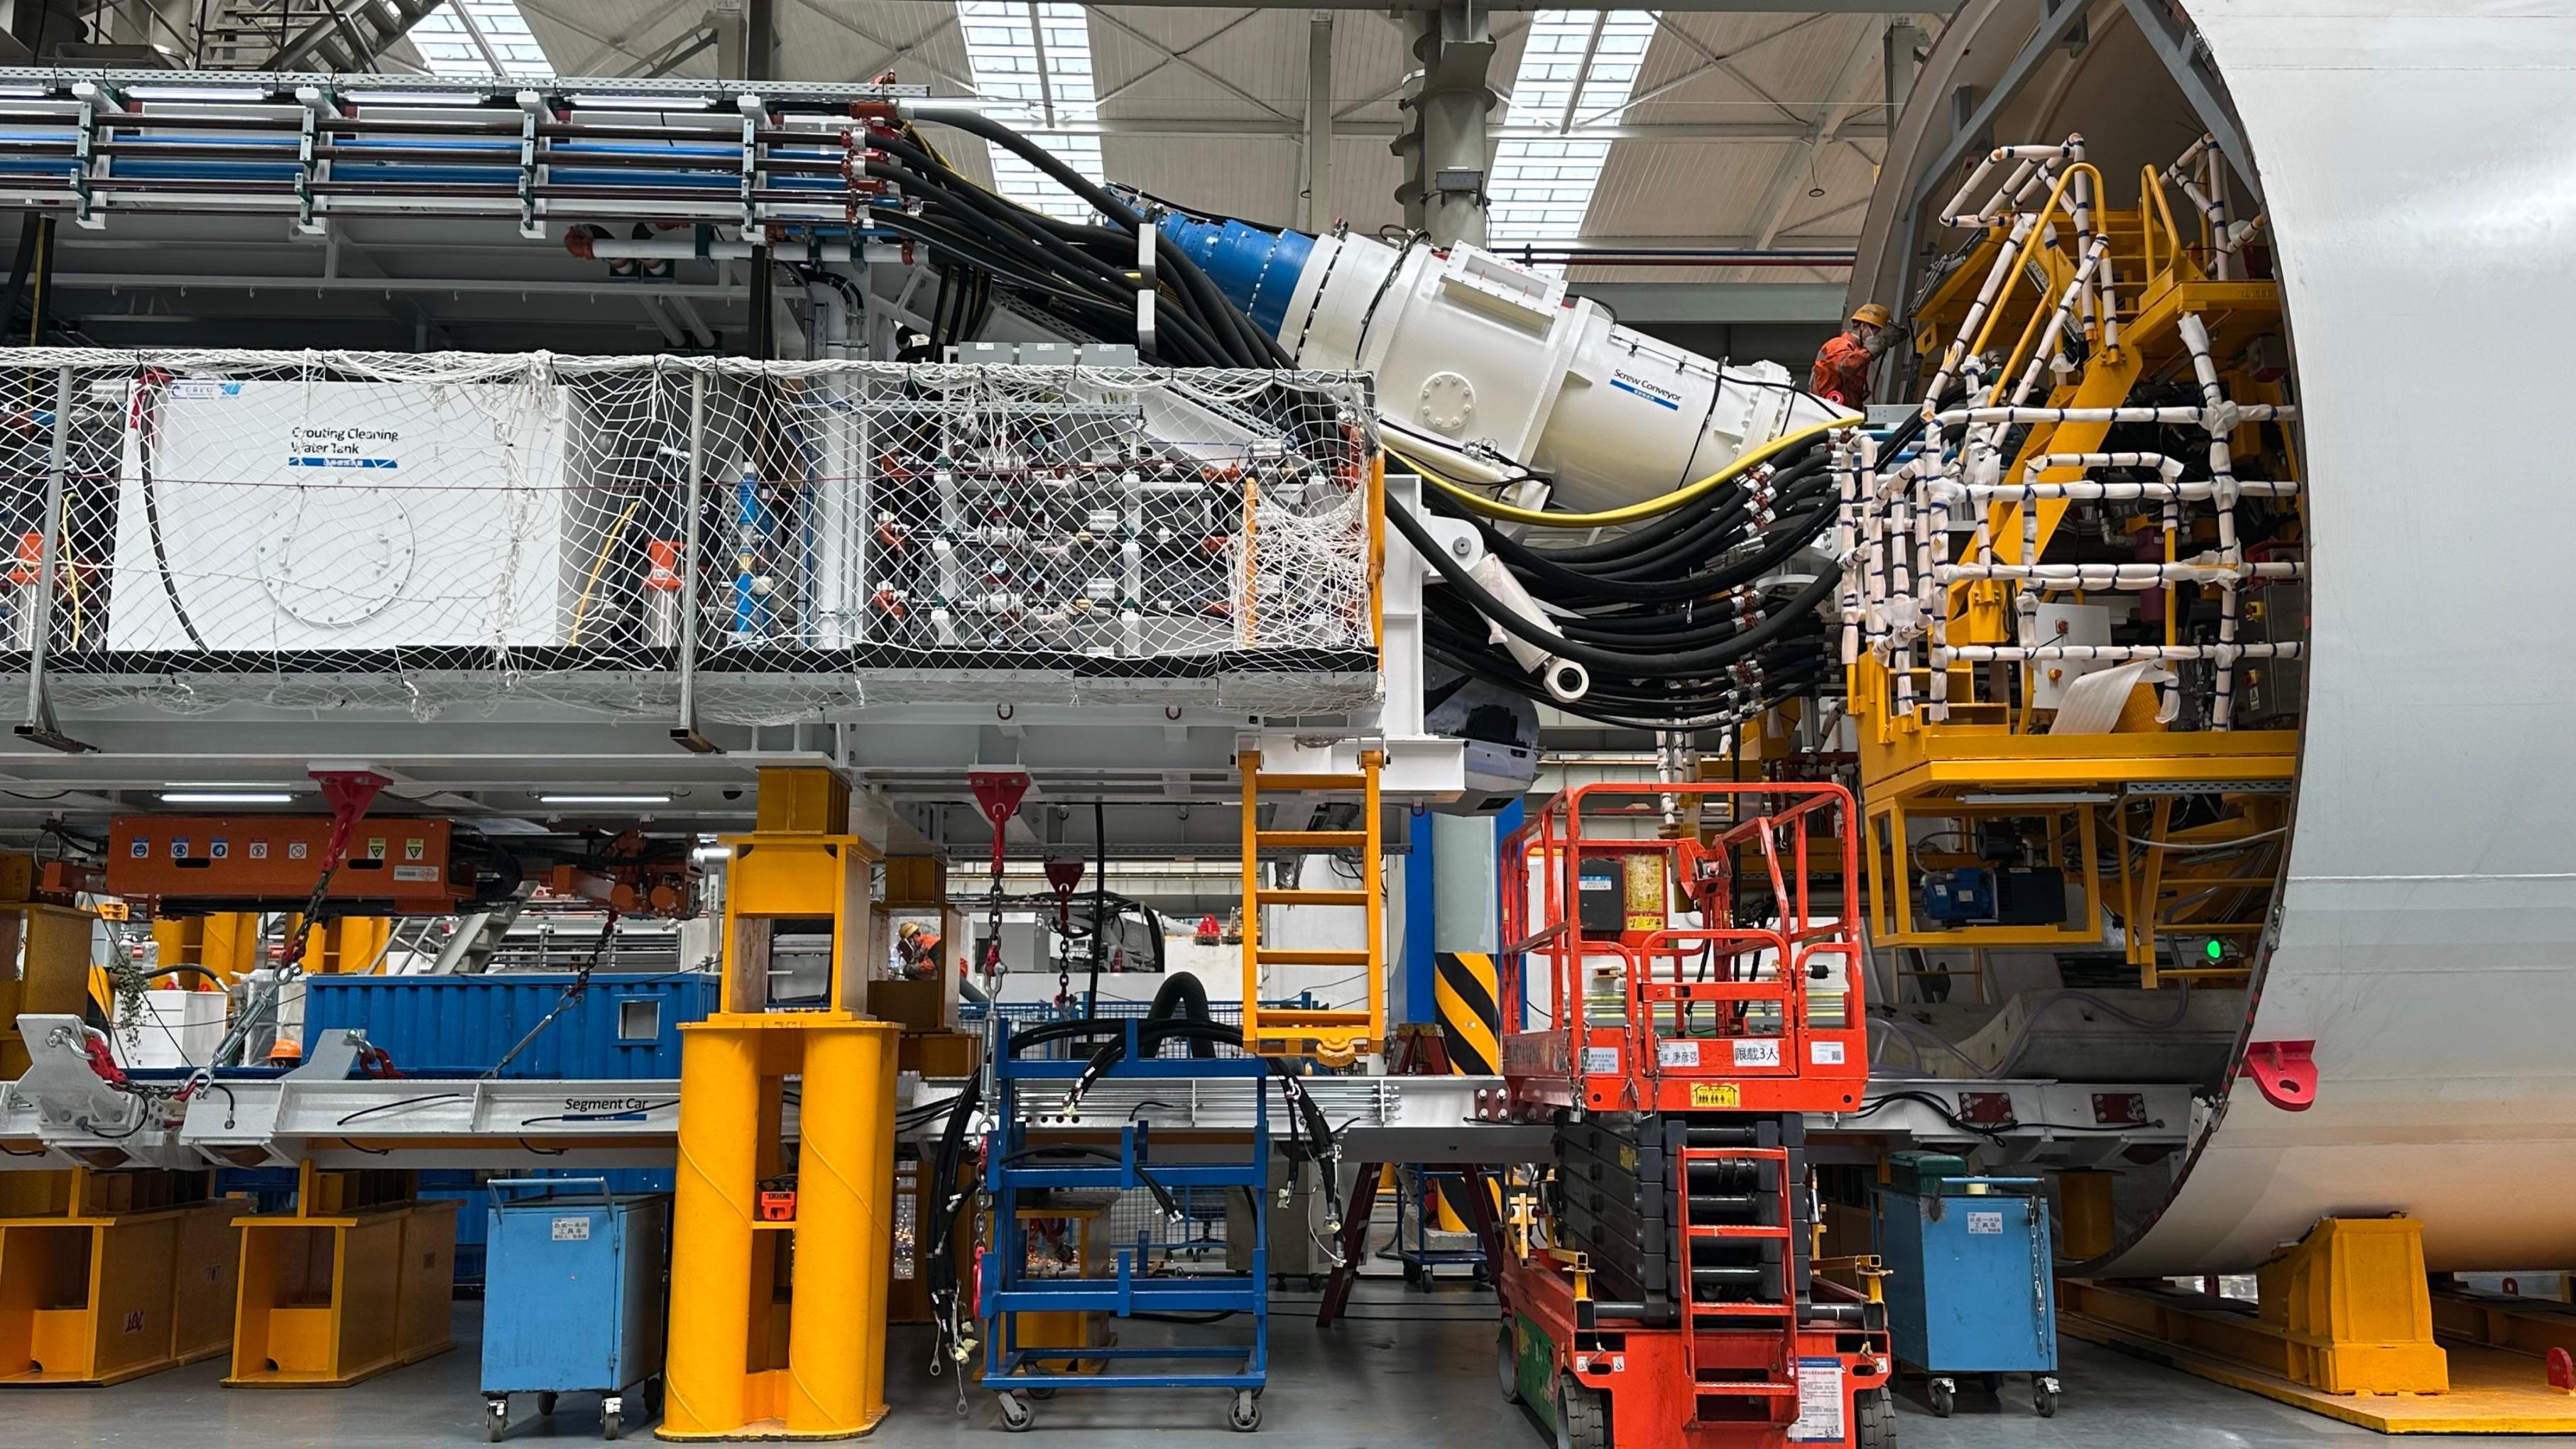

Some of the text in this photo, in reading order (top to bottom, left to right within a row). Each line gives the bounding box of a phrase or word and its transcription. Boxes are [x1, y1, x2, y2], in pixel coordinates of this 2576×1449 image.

[1613, 368, 1641, 385] Screw
[1641, 380, 1682, 402] Conveyor
[347, 427, 399, 442] Cleaning
[1735, 1046, 1778, 1061] 限载3人
[564, 1098, 649, 1112] Segment Car
